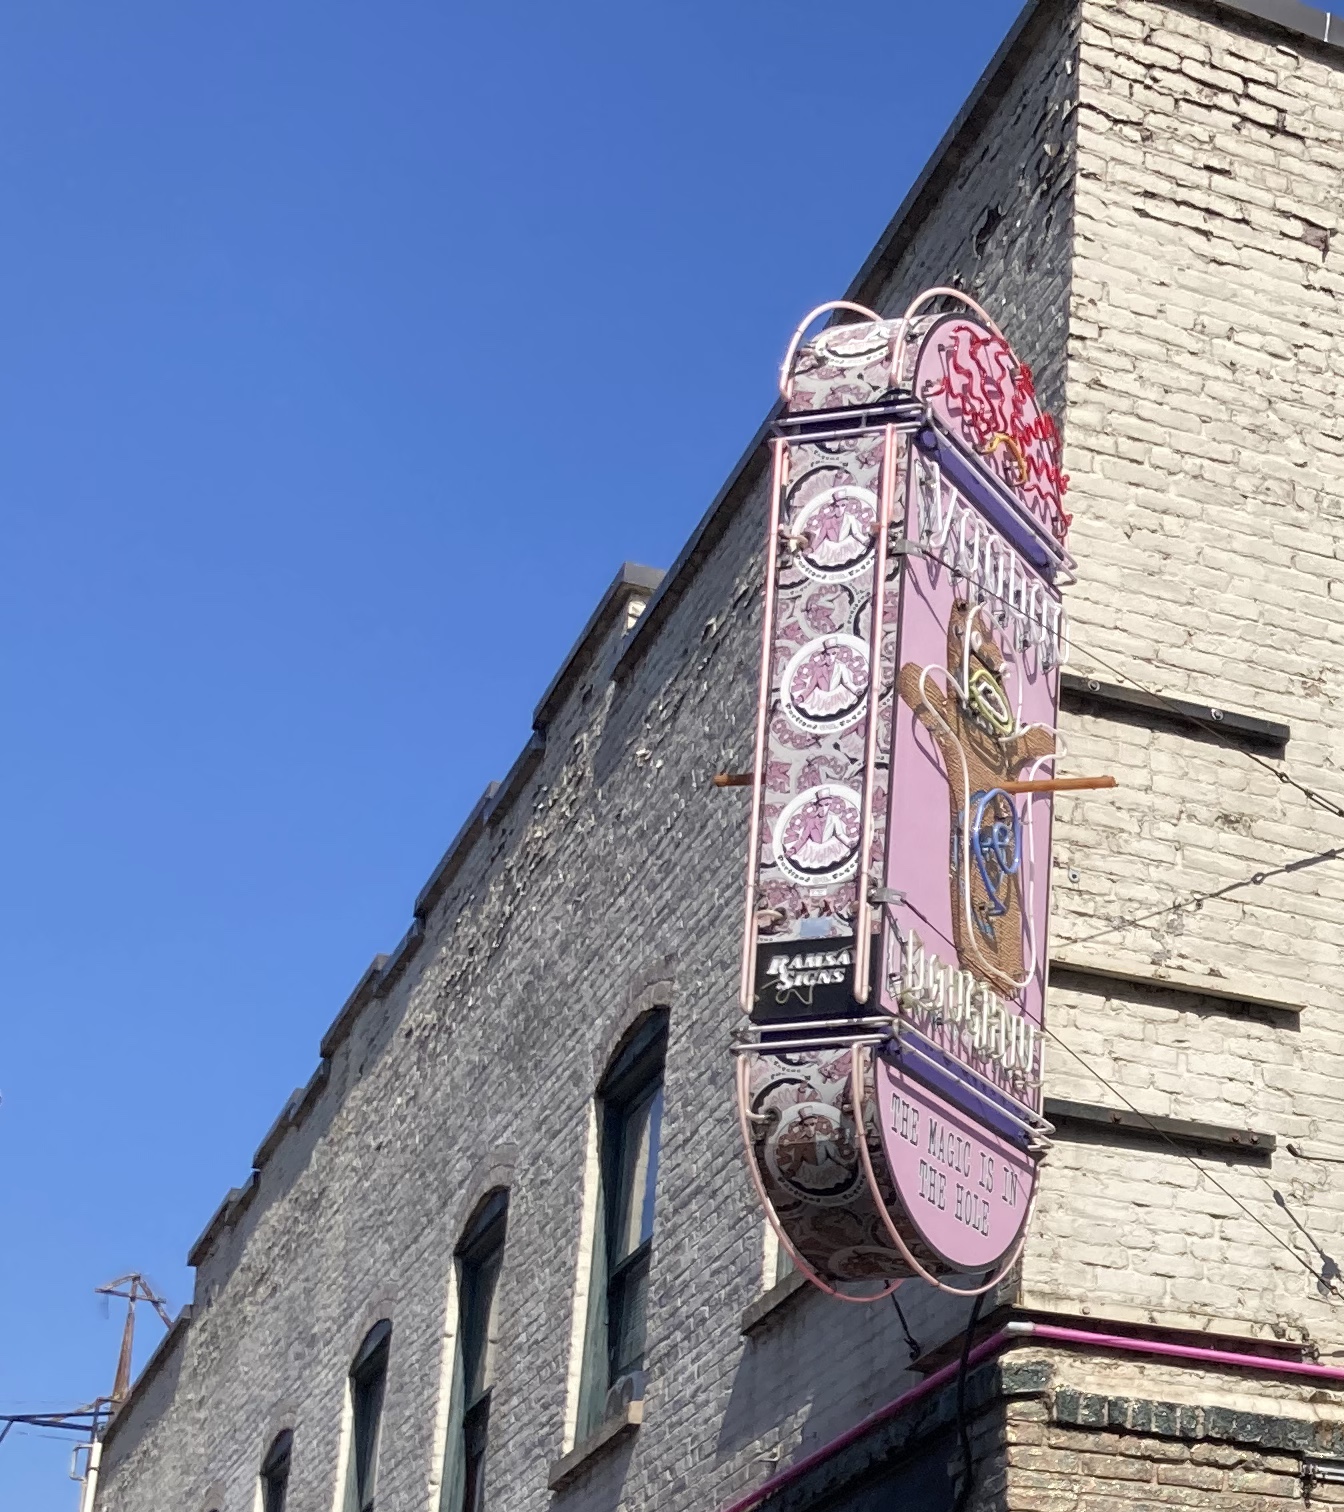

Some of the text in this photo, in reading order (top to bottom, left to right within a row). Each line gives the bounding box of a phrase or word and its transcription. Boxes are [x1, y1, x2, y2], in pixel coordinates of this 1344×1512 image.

[775, 967, 846, 990] SIGNS
[891, 1092, 1018, 1207] THE MAGIC IS IN
[918, 1158, 991, 1236] THE HOLE
